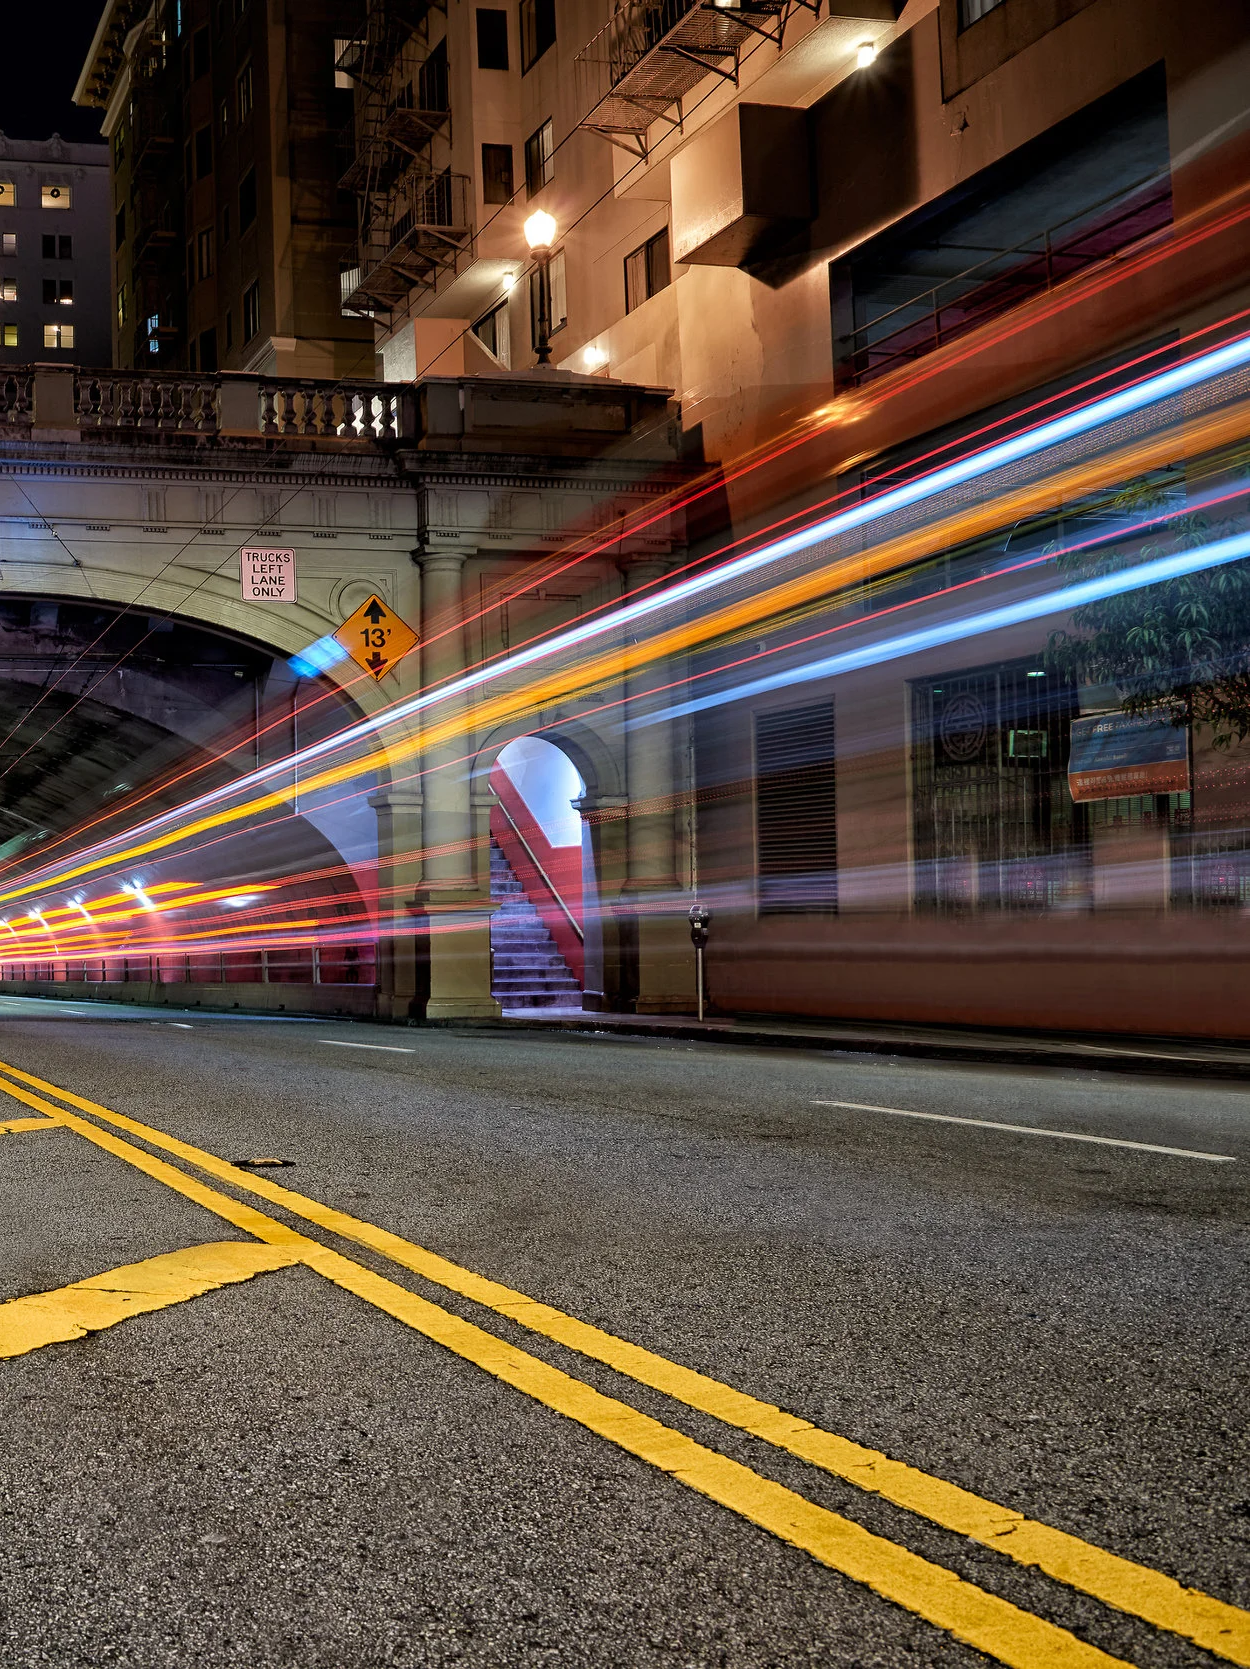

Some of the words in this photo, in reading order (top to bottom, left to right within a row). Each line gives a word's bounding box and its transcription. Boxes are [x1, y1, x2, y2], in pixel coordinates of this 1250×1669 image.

[246, 552, 291, 563] TRUCKS
[252, 564, 284, 574] LEFT
[251, 576, 286, 586] LANE
[252, 587, 285, 597] ONLY
[1092, 723, 1114, 733] FREE
